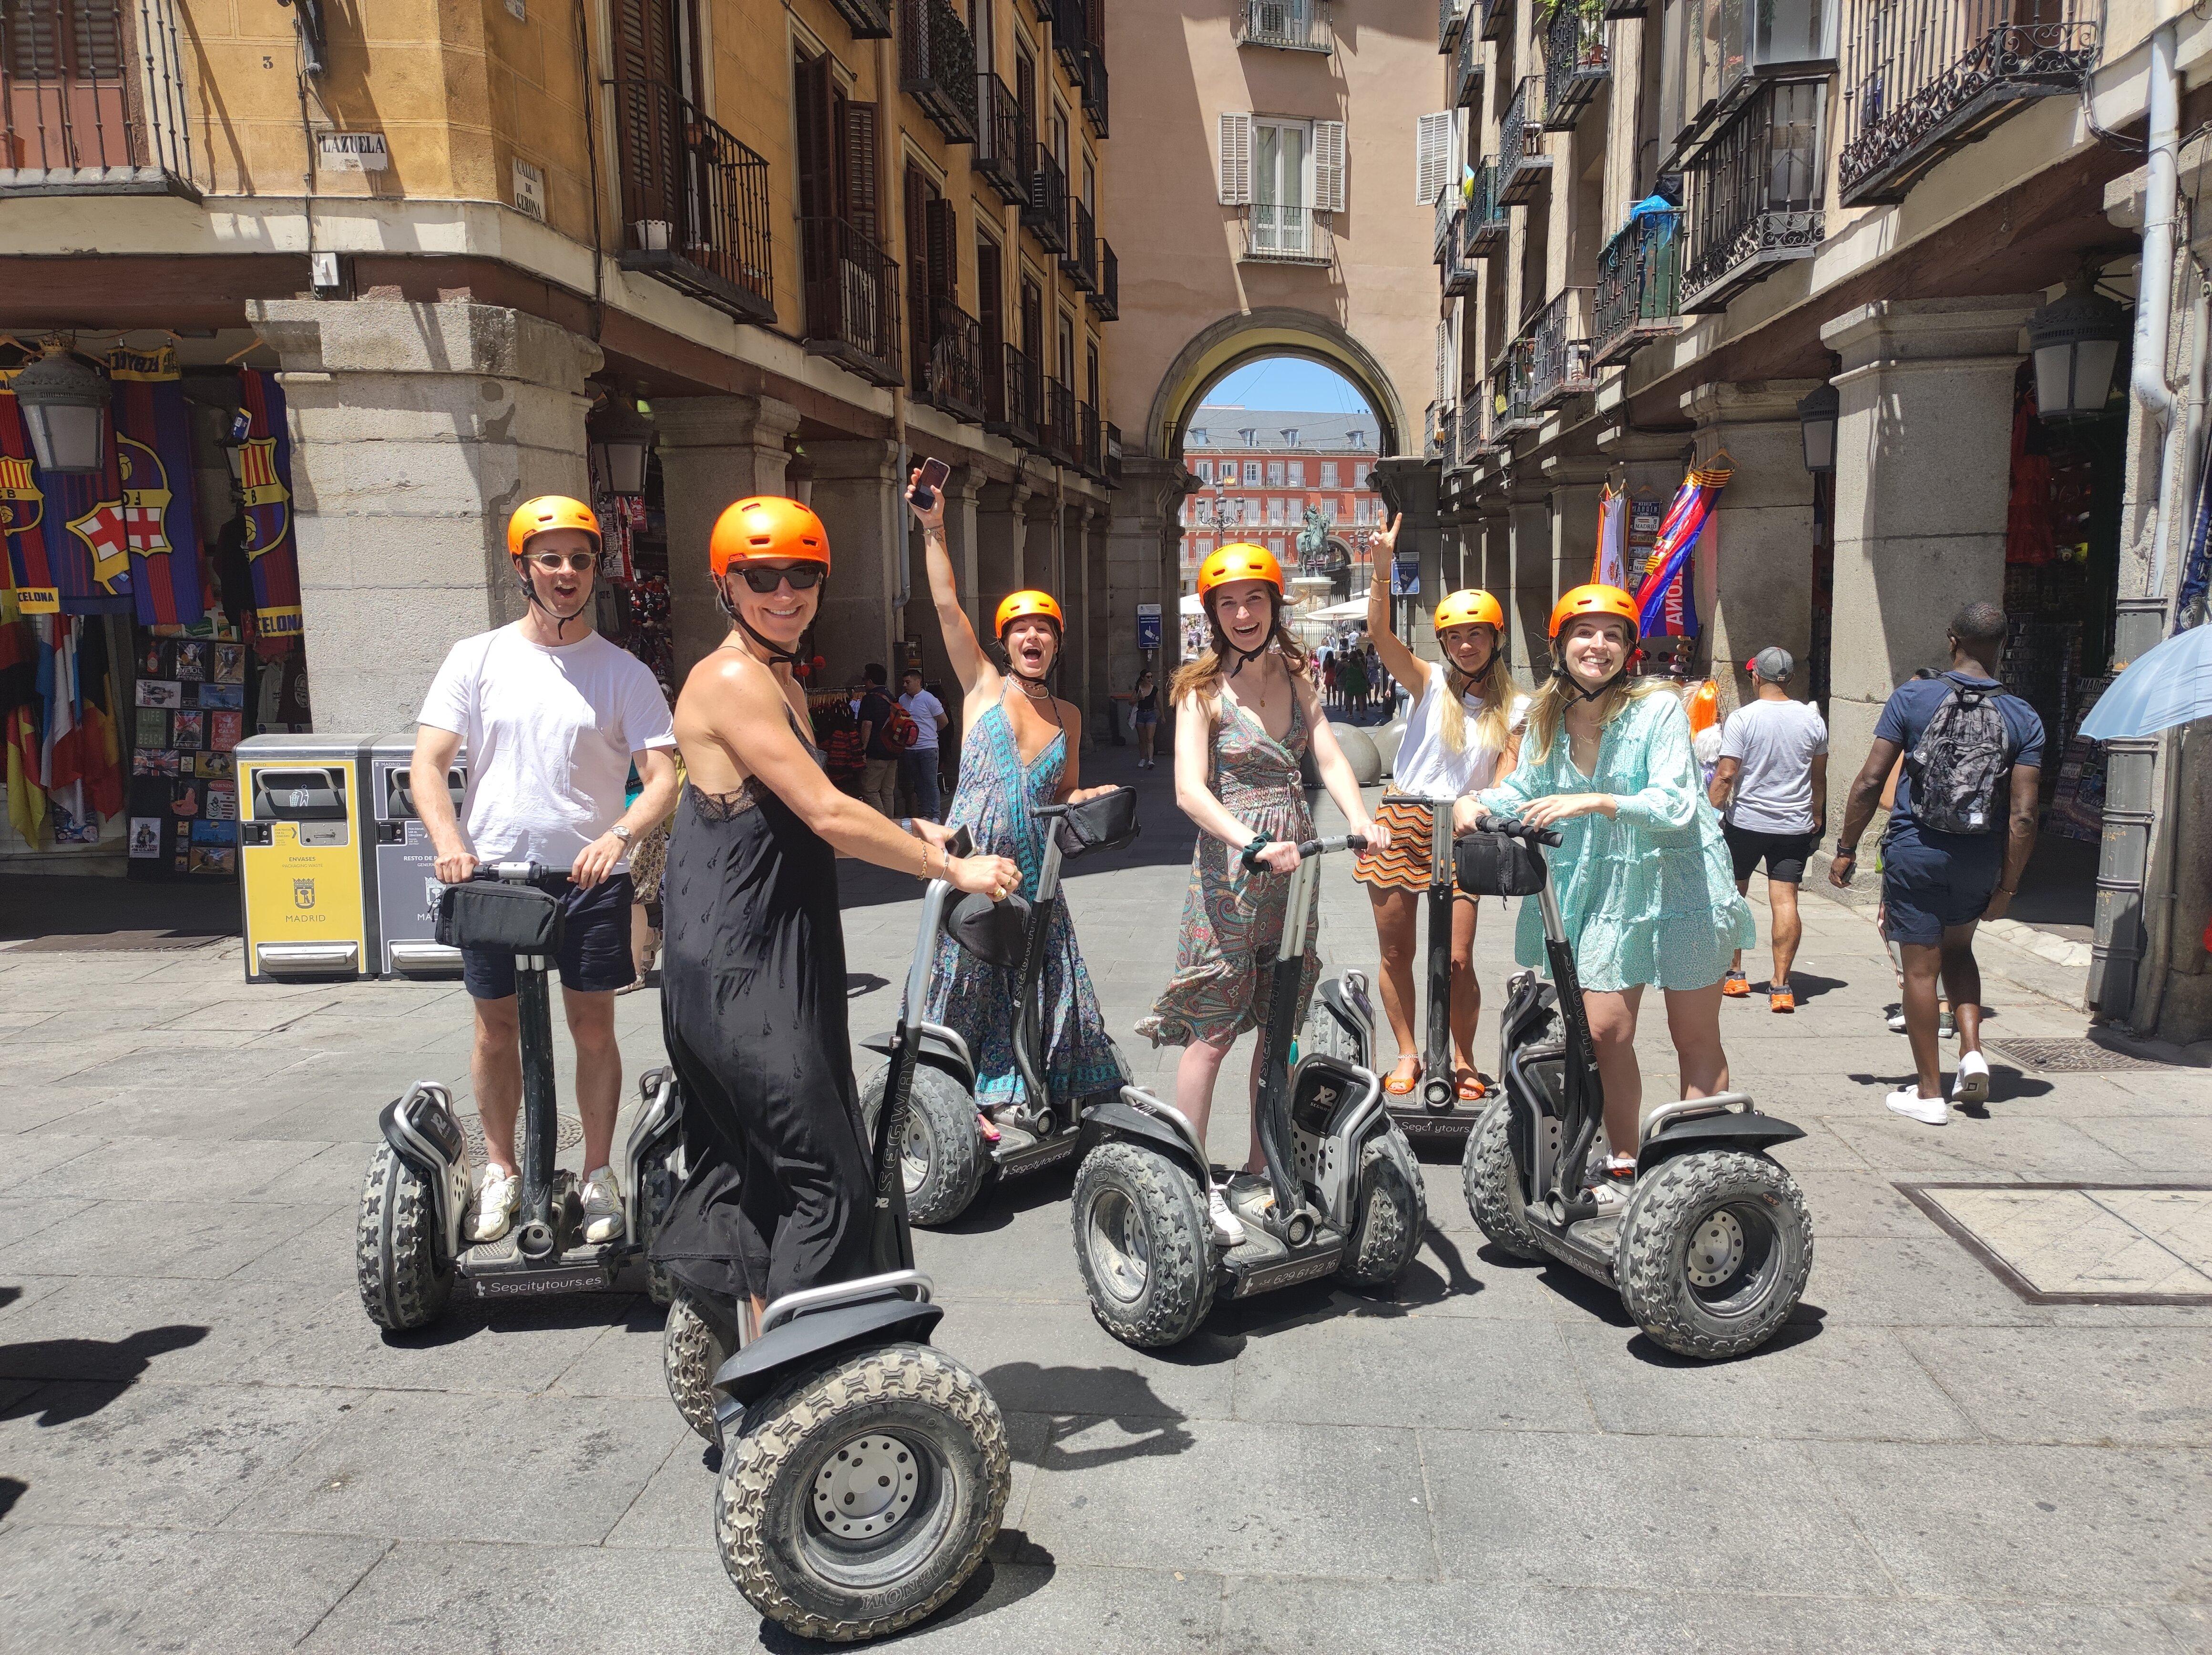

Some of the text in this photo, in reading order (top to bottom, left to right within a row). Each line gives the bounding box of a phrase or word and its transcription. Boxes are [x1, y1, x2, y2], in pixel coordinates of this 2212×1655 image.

[263, 56, 274, 69] 3
[516, 159, 537, 183] CALLE
[525, 183, 532, 194] DE
[516, 193, 542, 219] GERONA
[143, 711, 160, 722] LIFE
[138, 734, 163, 745] BEACH
[1563, 953, 1596, 1057] SEGWAY
[1312, 1085, 1337, 1107] X2
[878, 1048, 917, 1192] SEGWAY
[874, 1196, 890, 1208] X2
[1540, 1235, 1608, 1280] Segcitytours.es
[1273, 1271, 1296, 1285] 629
[1296, 1267, 1310, 1278] 61
[1309, 1262, 1325, 1275] 22
[1325, 1258, 1338, 1270] 16
[490, 1277, 602, 1293] Segcitytours.es
[859, 1553, 953, 1612] VENOM
